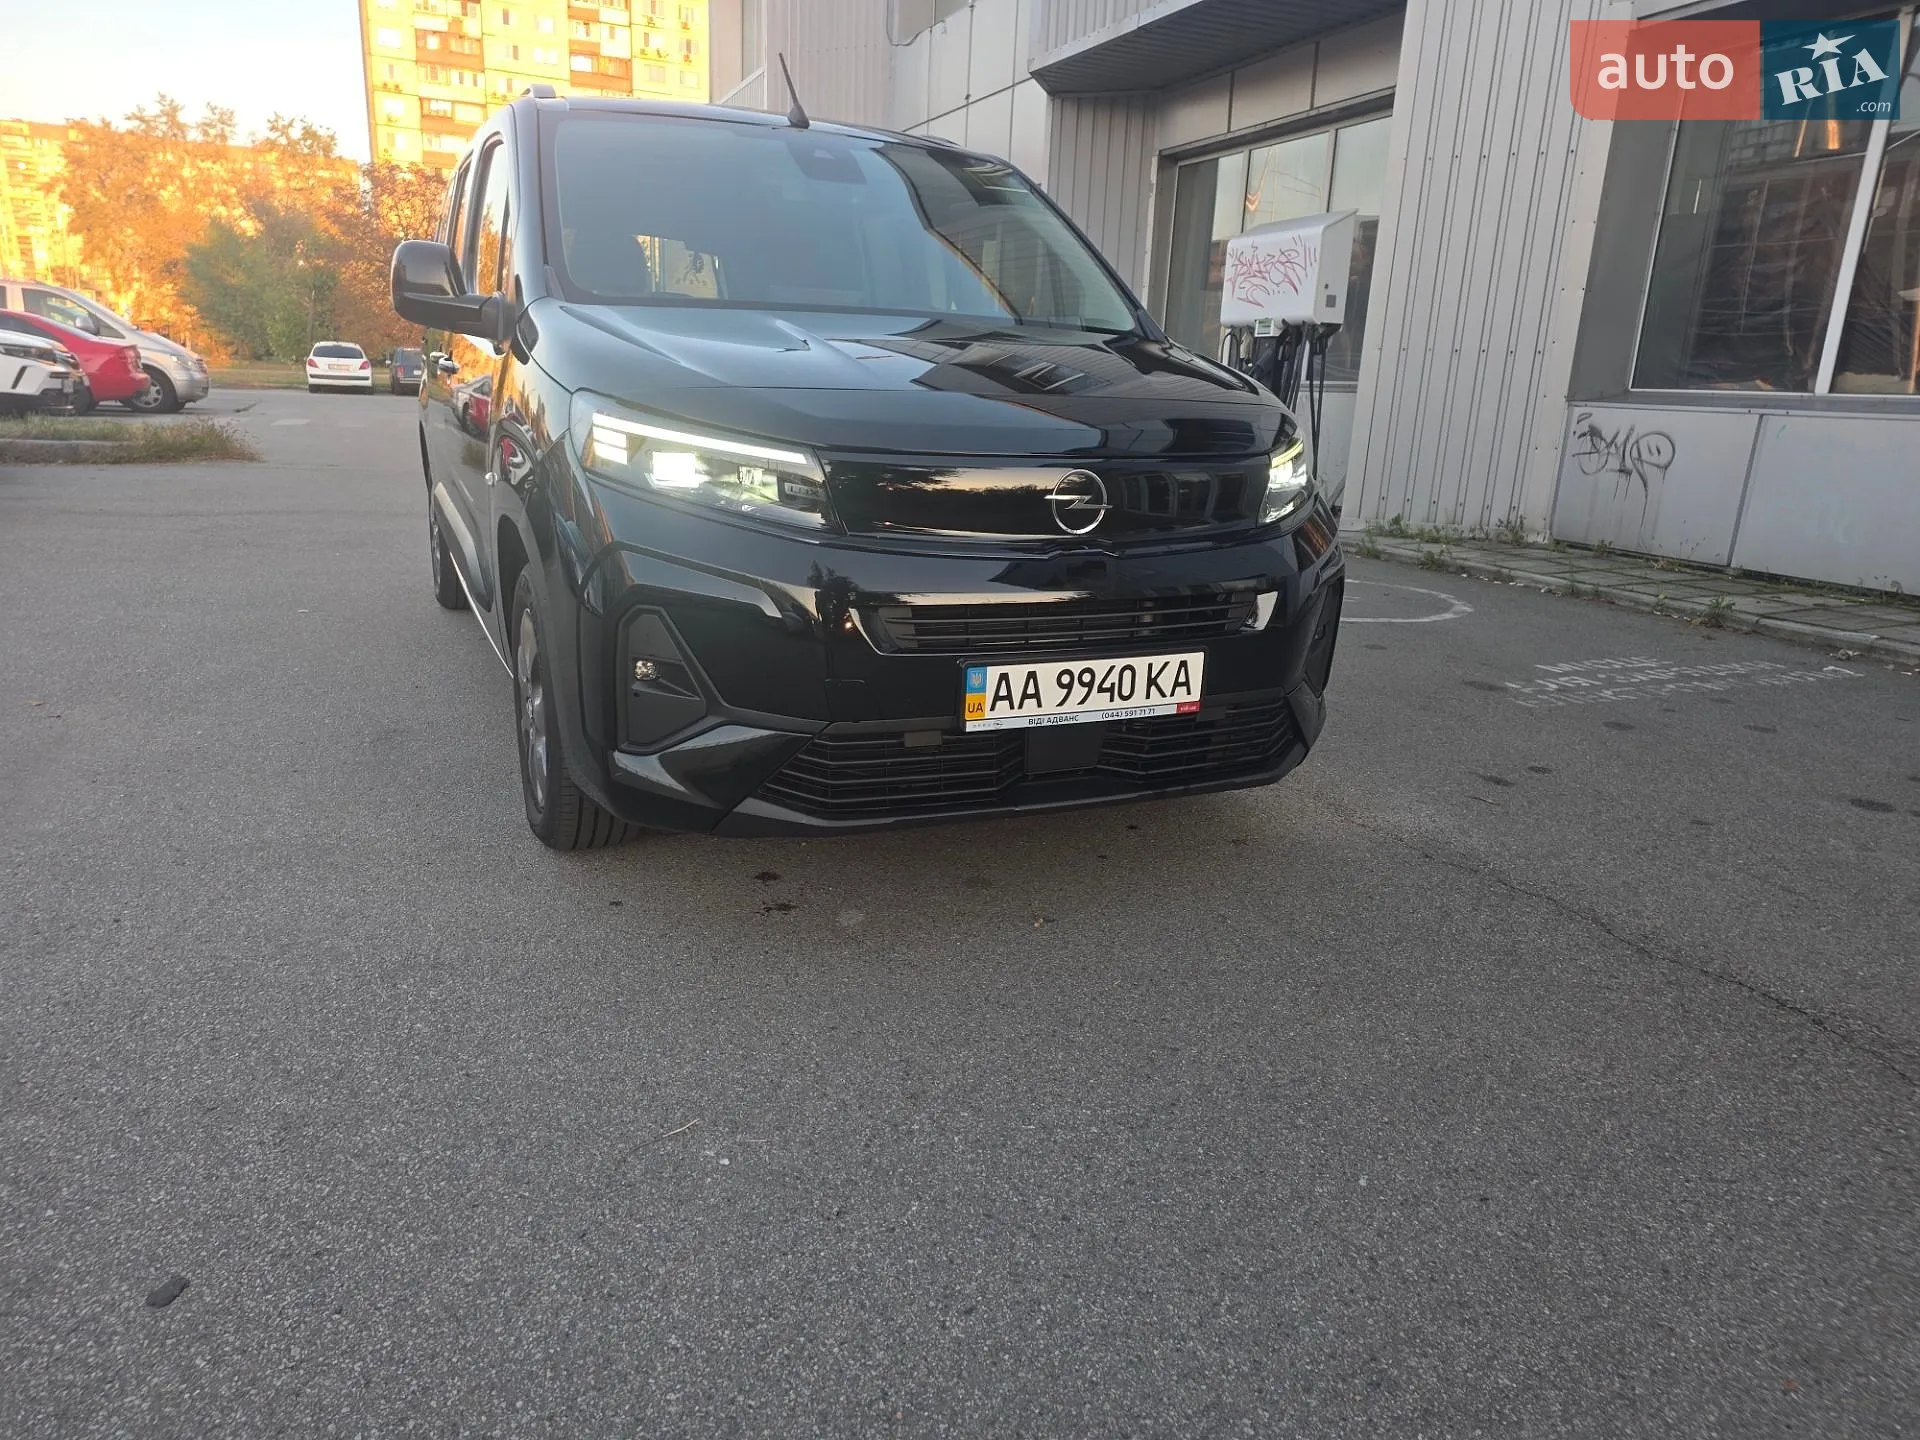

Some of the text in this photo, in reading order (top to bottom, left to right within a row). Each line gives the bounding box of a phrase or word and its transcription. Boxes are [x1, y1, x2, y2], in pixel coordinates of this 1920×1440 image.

[989, 659, 1193, 712] AA 9940 KA
[967, 701, 984, 714] UA
[1046, 714, 1080, 725] АДВАНС
[1101, 710, 1123, 719] (044)
[1124, 709, 1137, 717] 591
